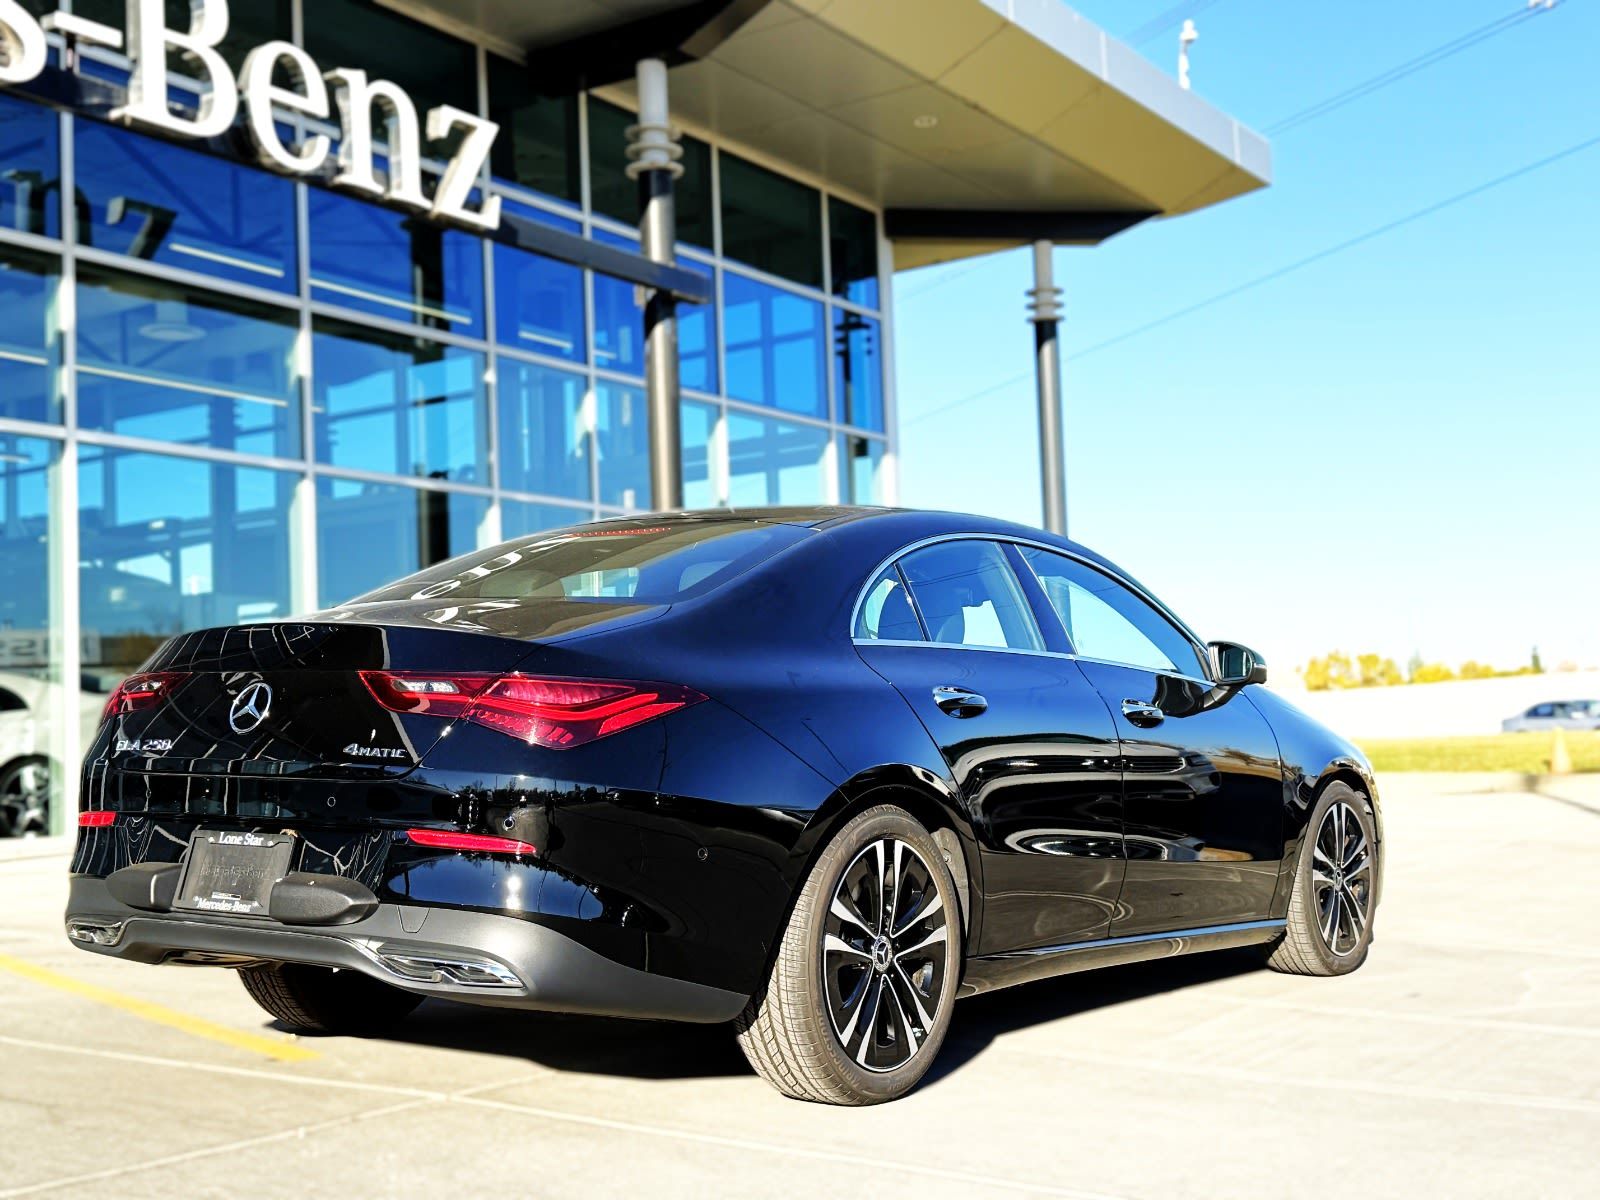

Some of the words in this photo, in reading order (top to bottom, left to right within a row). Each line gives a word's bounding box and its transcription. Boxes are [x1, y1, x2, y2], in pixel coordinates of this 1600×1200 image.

[342, 743, 408, 758] 4MATIC
[219, 832, 242, 845] Lone
[243, 833, 264, 846] Star
[197, 898, 251, 912] Mercedes-Benz
